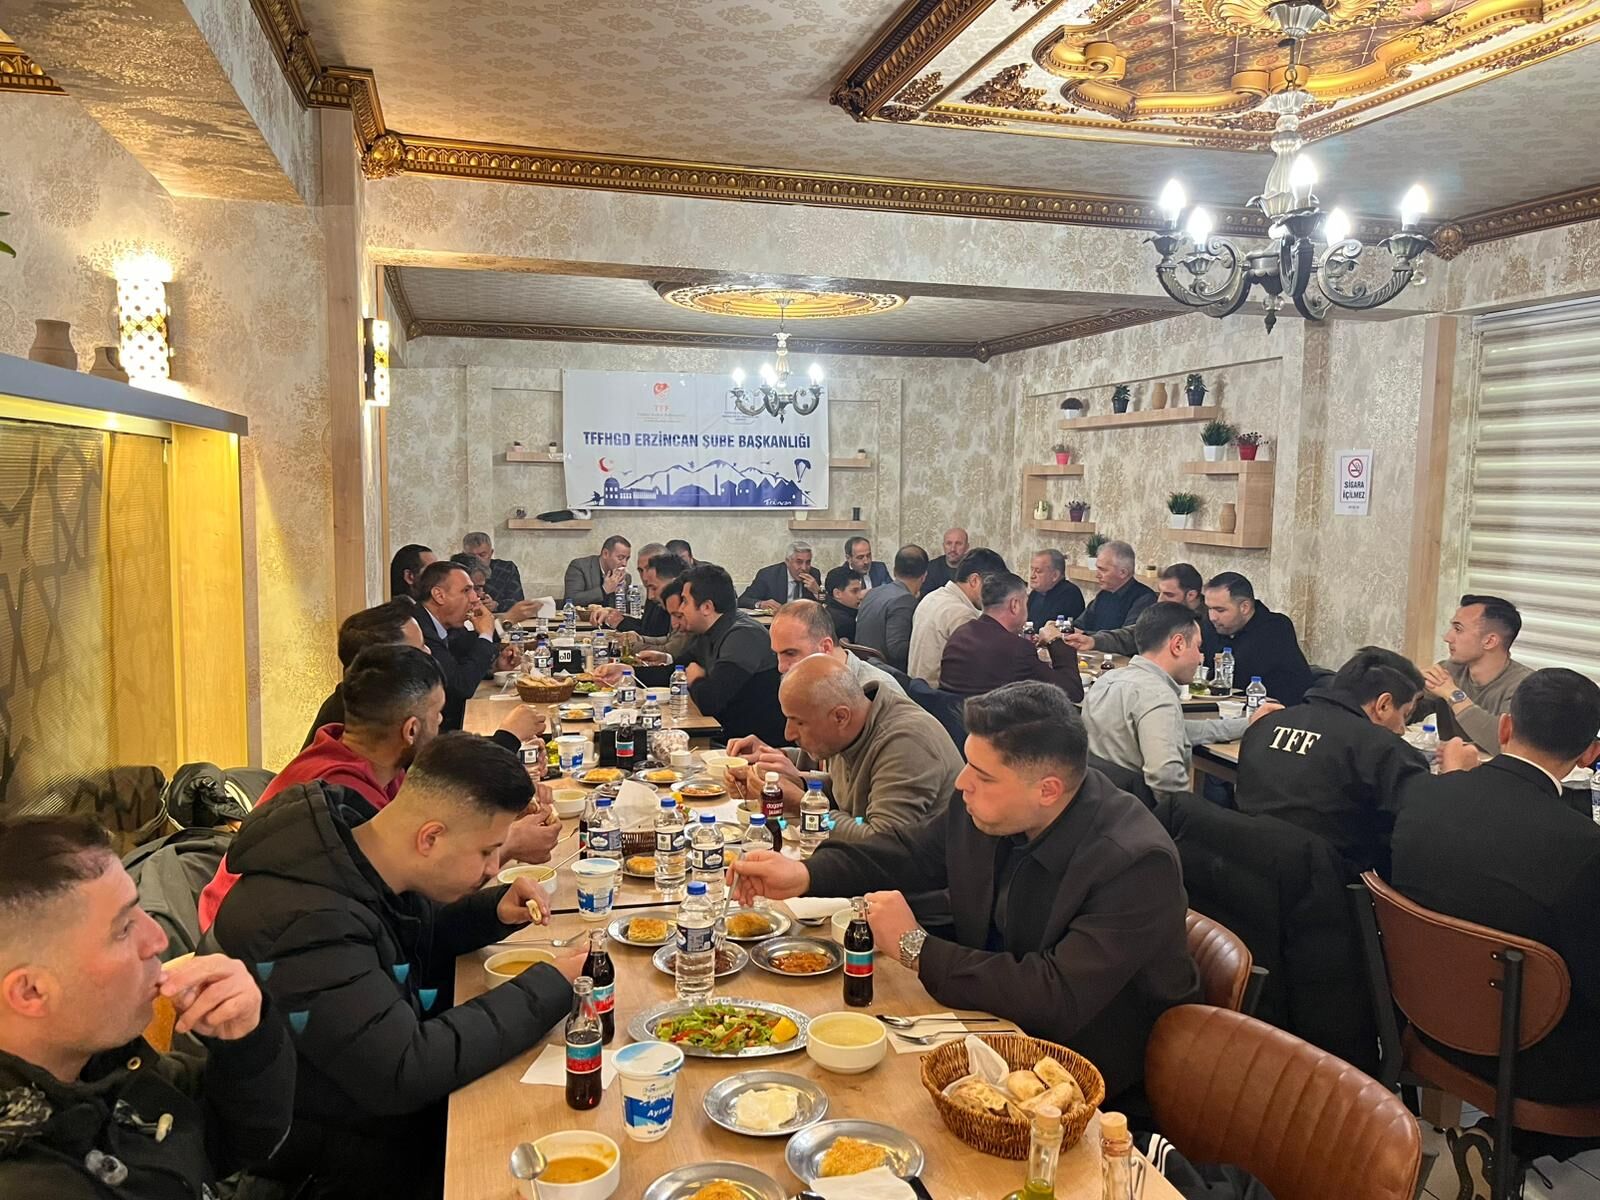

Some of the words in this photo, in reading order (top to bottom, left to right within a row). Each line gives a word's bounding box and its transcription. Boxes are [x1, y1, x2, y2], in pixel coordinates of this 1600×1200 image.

[583, 431, 631, 446] TFFHGD
[634, 430, 698, 447] ERZİNCAN
[702, 434, 735, 449] ŞUBE
[738, 432, 811, 449] BAŞKANLIĞI
[1343, 479, 1365, 489] SİGARA
[1342, 489, 1366, 500] İÇİLMEZ
[1268, 725, 1322, 755] TFF
[646, 1104, 671, 1118] Ayran
